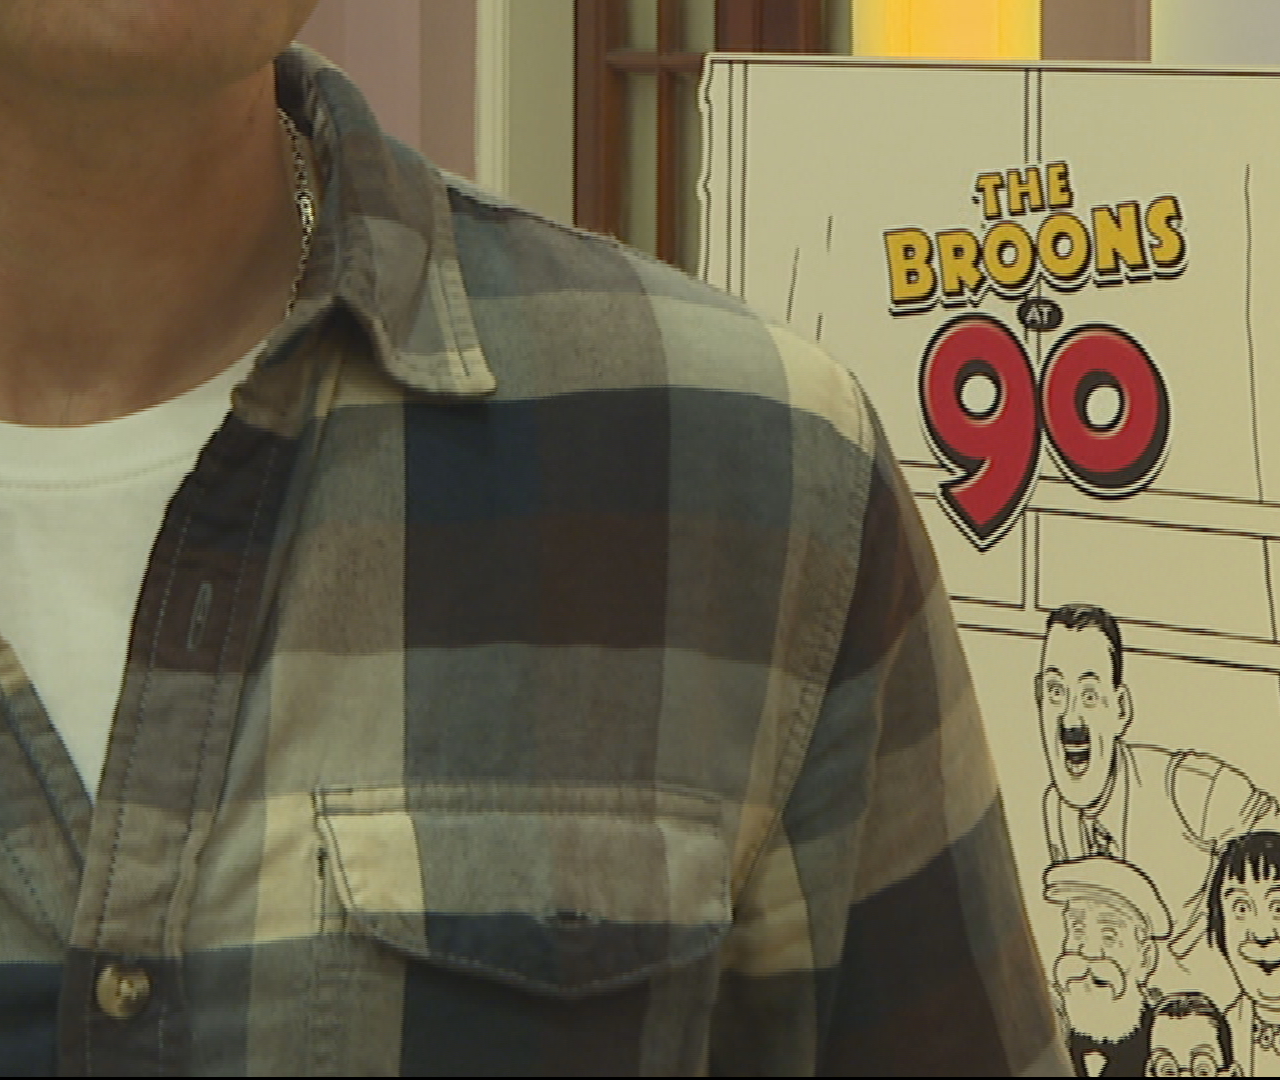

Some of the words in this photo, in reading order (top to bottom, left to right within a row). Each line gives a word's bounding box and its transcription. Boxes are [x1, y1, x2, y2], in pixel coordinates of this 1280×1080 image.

[973, 160, 1074, 221] THE
[883, 194, 1188, 317] BROONS
[1024, 303, 1054, 326] AT
[920, 312, 1171, 553] 90
